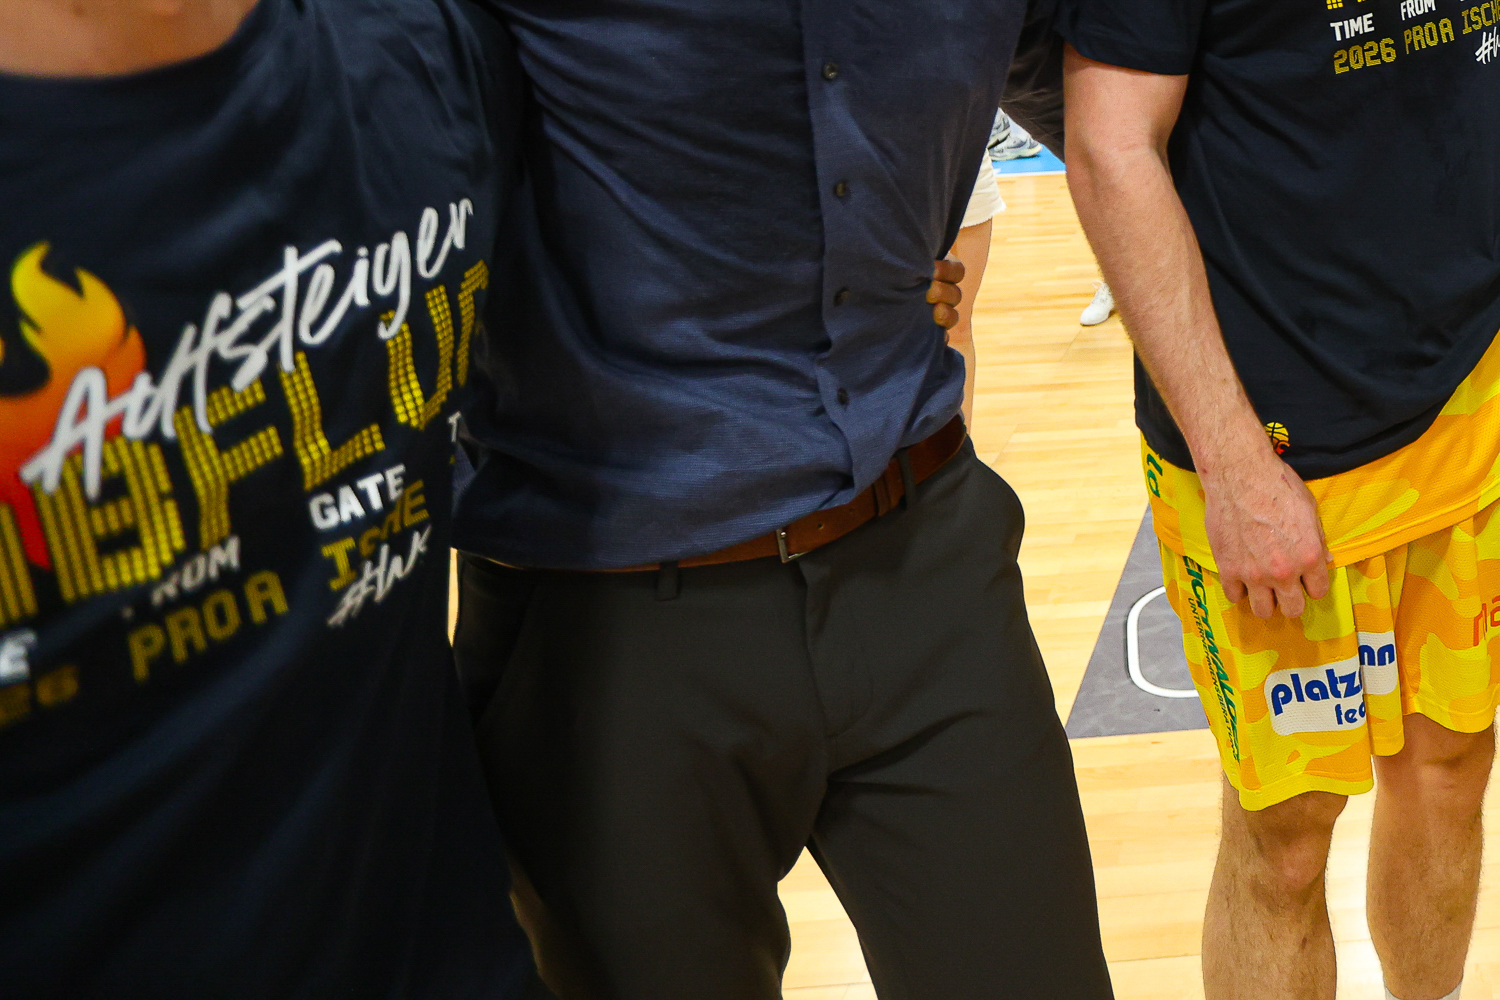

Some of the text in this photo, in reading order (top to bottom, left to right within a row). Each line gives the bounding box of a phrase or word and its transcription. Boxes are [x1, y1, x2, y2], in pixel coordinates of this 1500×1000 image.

[1330, 12, 1375, 42] TIME
[1333, 37, 1397, 75] 2026
[19, 198, 474, 499] Aufsteiger
[308, 463, 407, 531] GATE
